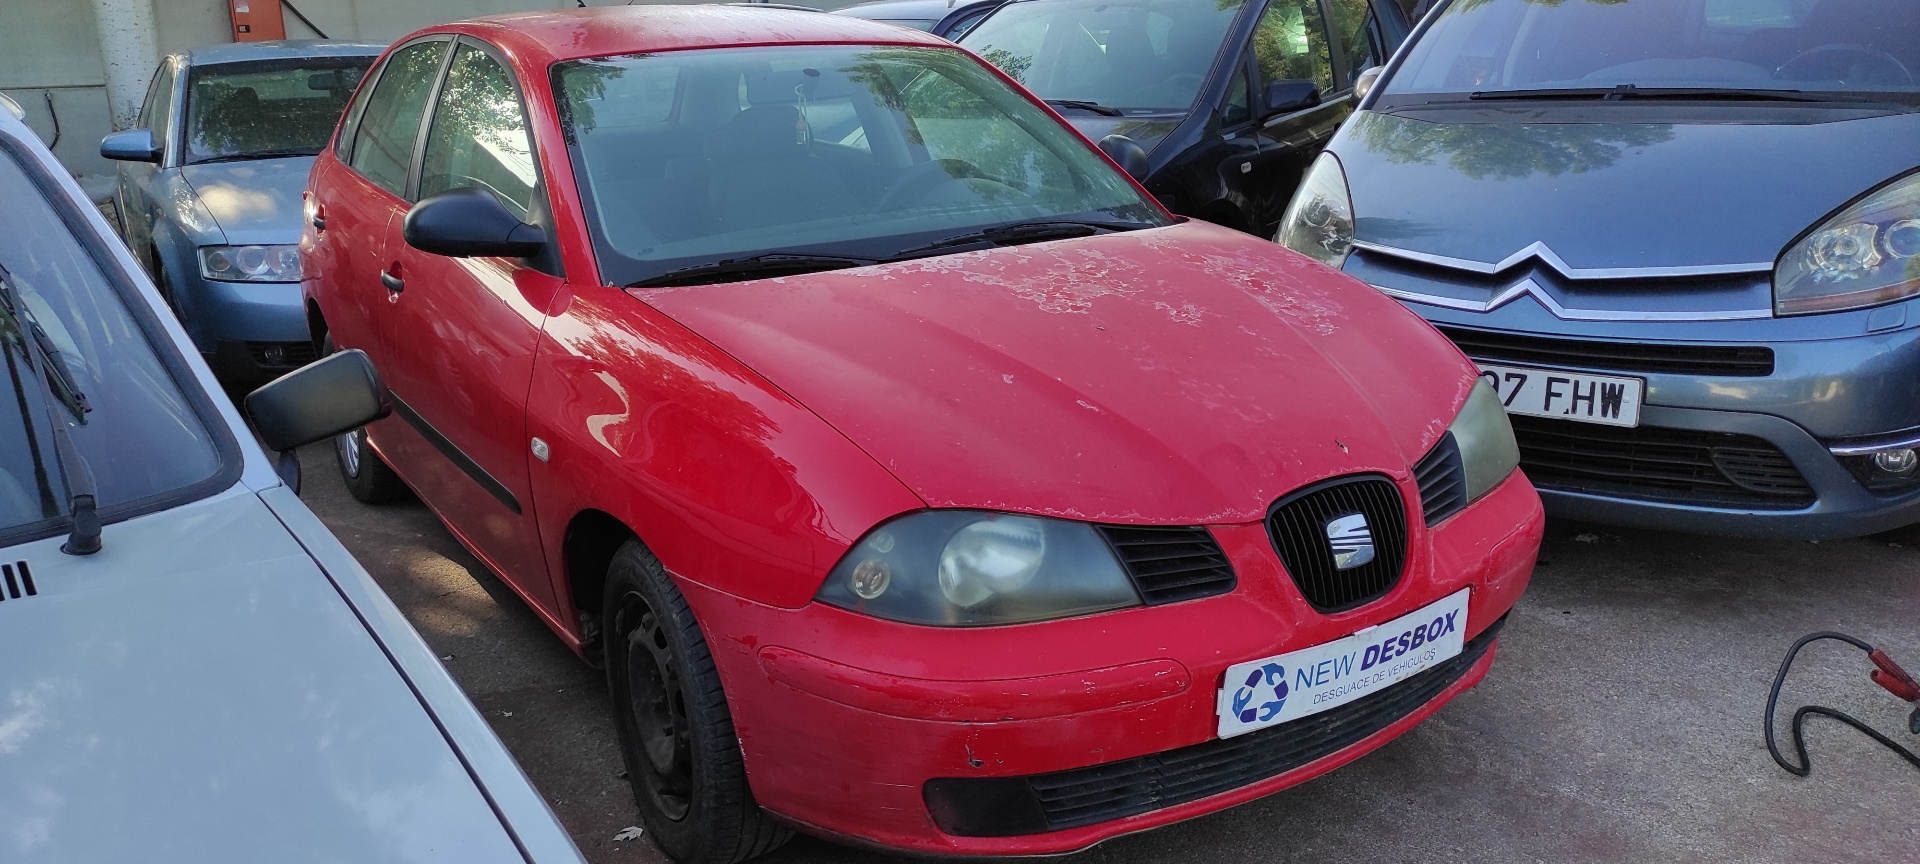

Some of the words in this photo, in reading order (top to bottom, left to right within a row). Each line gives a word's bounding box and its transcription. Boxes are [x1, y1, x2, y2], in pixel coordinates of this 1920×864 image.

[1543, 376, 1625, 419] FHW
[1295, 651, 1356, 691] NEW
[1360, 608, 1459, 671] DESBOX
[1313, 679, 1370, 705] DESGUACE
[1372, 672, 1386, 685] DE
[1387, 648, 1436, 677] VEHICULOS
